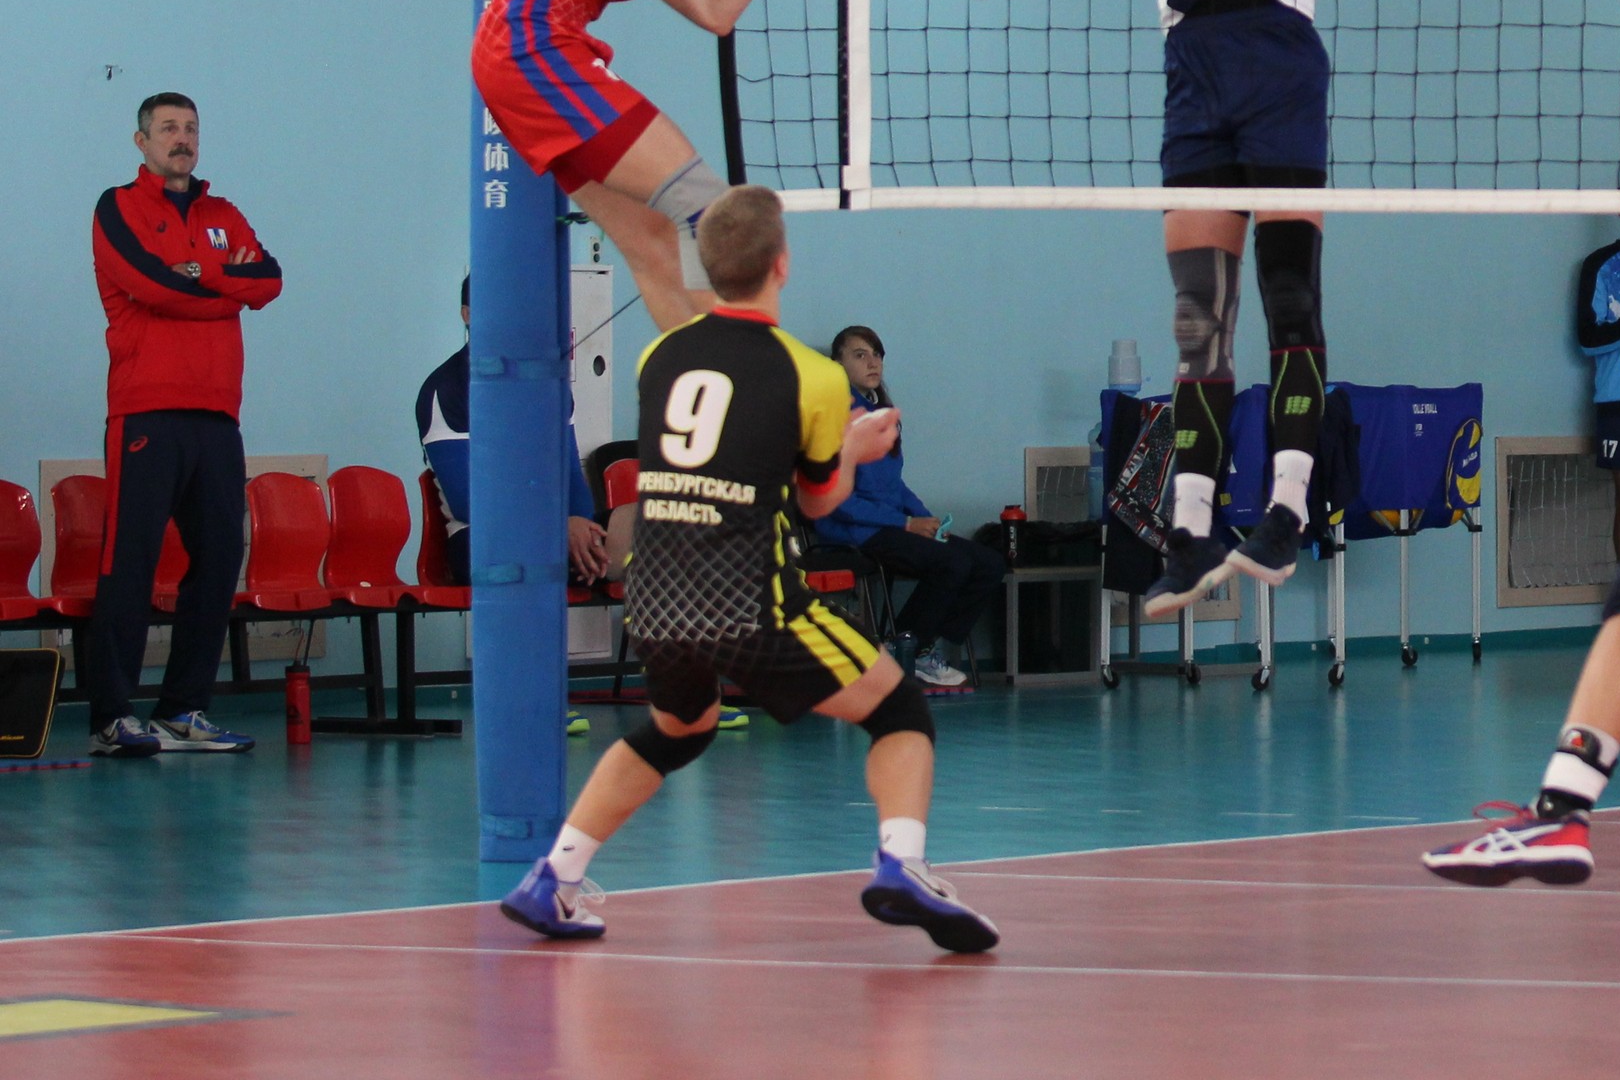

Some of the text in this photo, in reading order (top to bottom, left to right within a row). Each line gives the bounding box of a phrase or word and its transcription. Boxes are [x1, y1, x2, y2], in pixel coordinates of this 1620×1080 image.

[660, 369, 734, 469] 9
[1602, 439, 1618, 458] 17
[638, 471, 756, 505] РЕНБУРГСКАЯ
[644, 499, 722, 526] ОБЛАСТЬ
